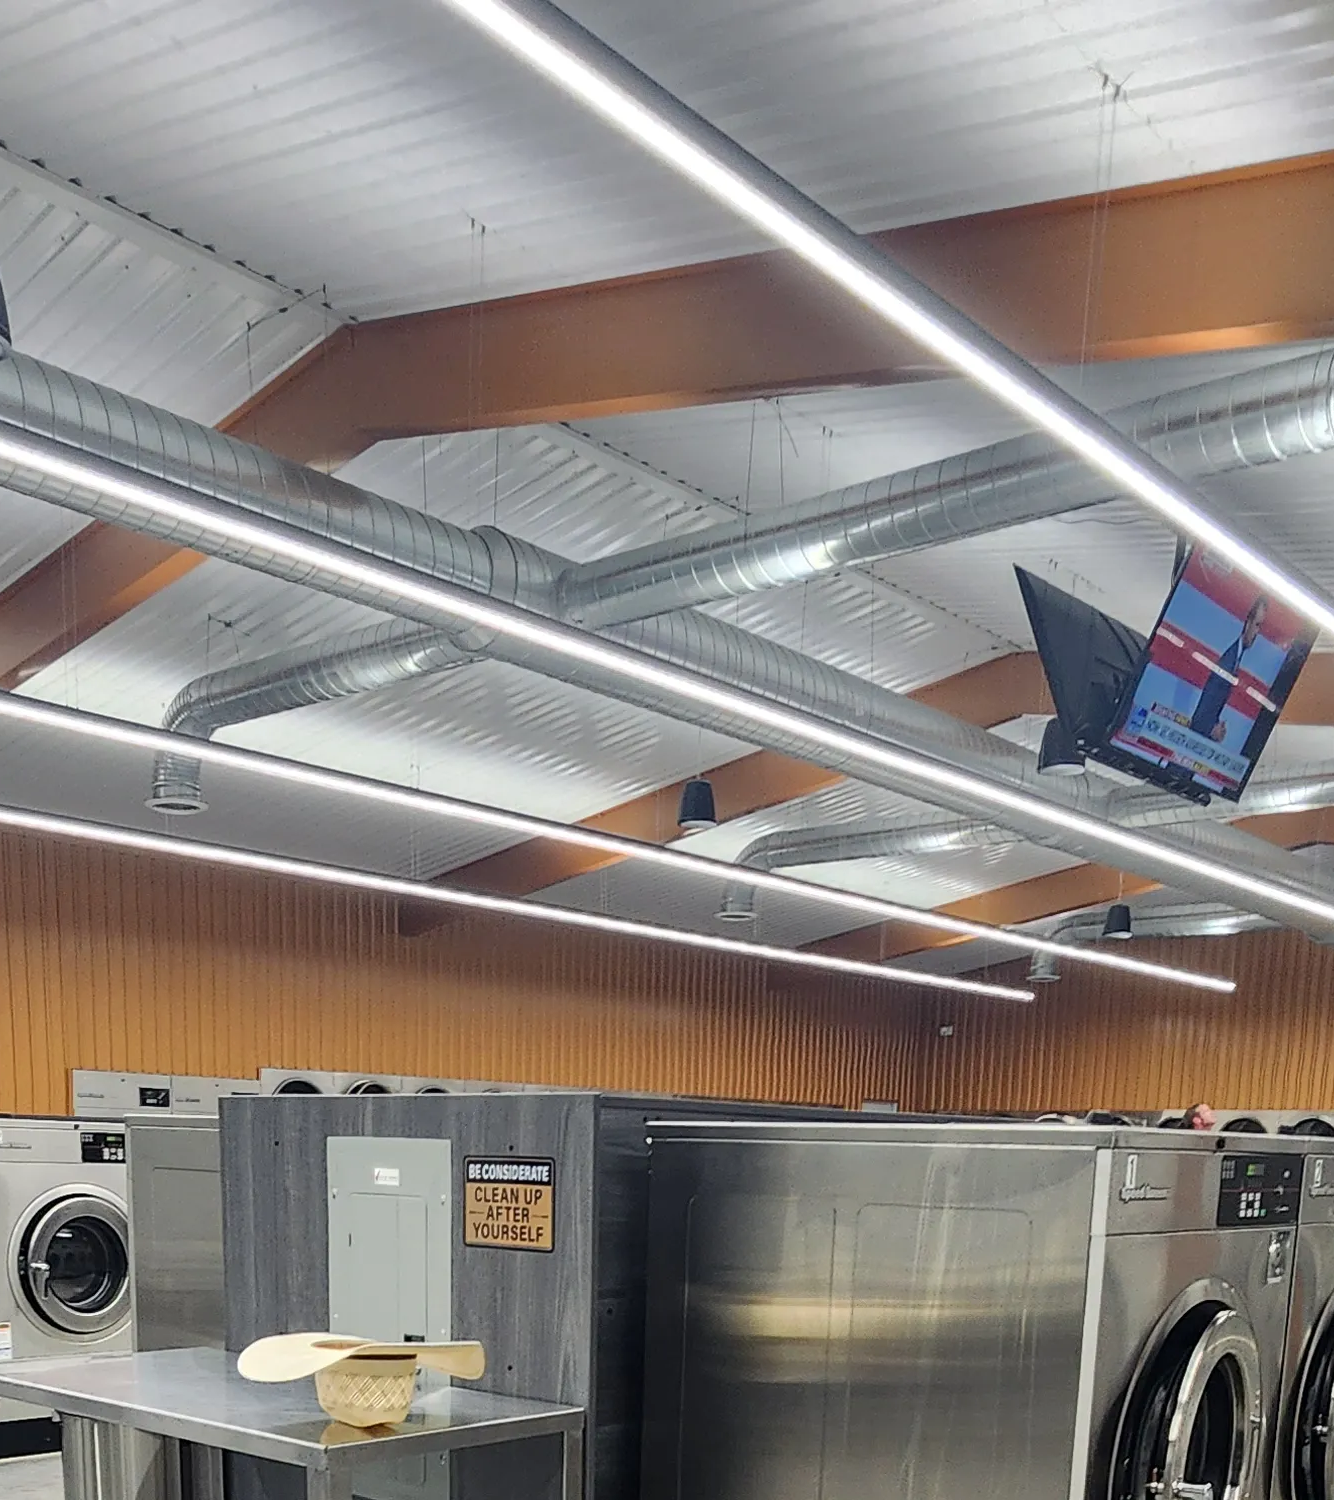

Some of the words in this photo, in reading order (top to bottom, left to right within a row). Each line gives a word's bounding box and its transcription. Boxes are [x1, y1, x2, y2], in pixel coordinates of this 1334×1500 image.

[468, 1164, 482, 1179] BE
[482, 1164, 550, 1182] CONSIDERATE
[474, 1186, 520, 1204] CLEAN
[524, 1188, 543, 1205] UP
[486, 1205, 530, 1223] AFTER
[473, 1222, 544, 1242] YOURSELF
